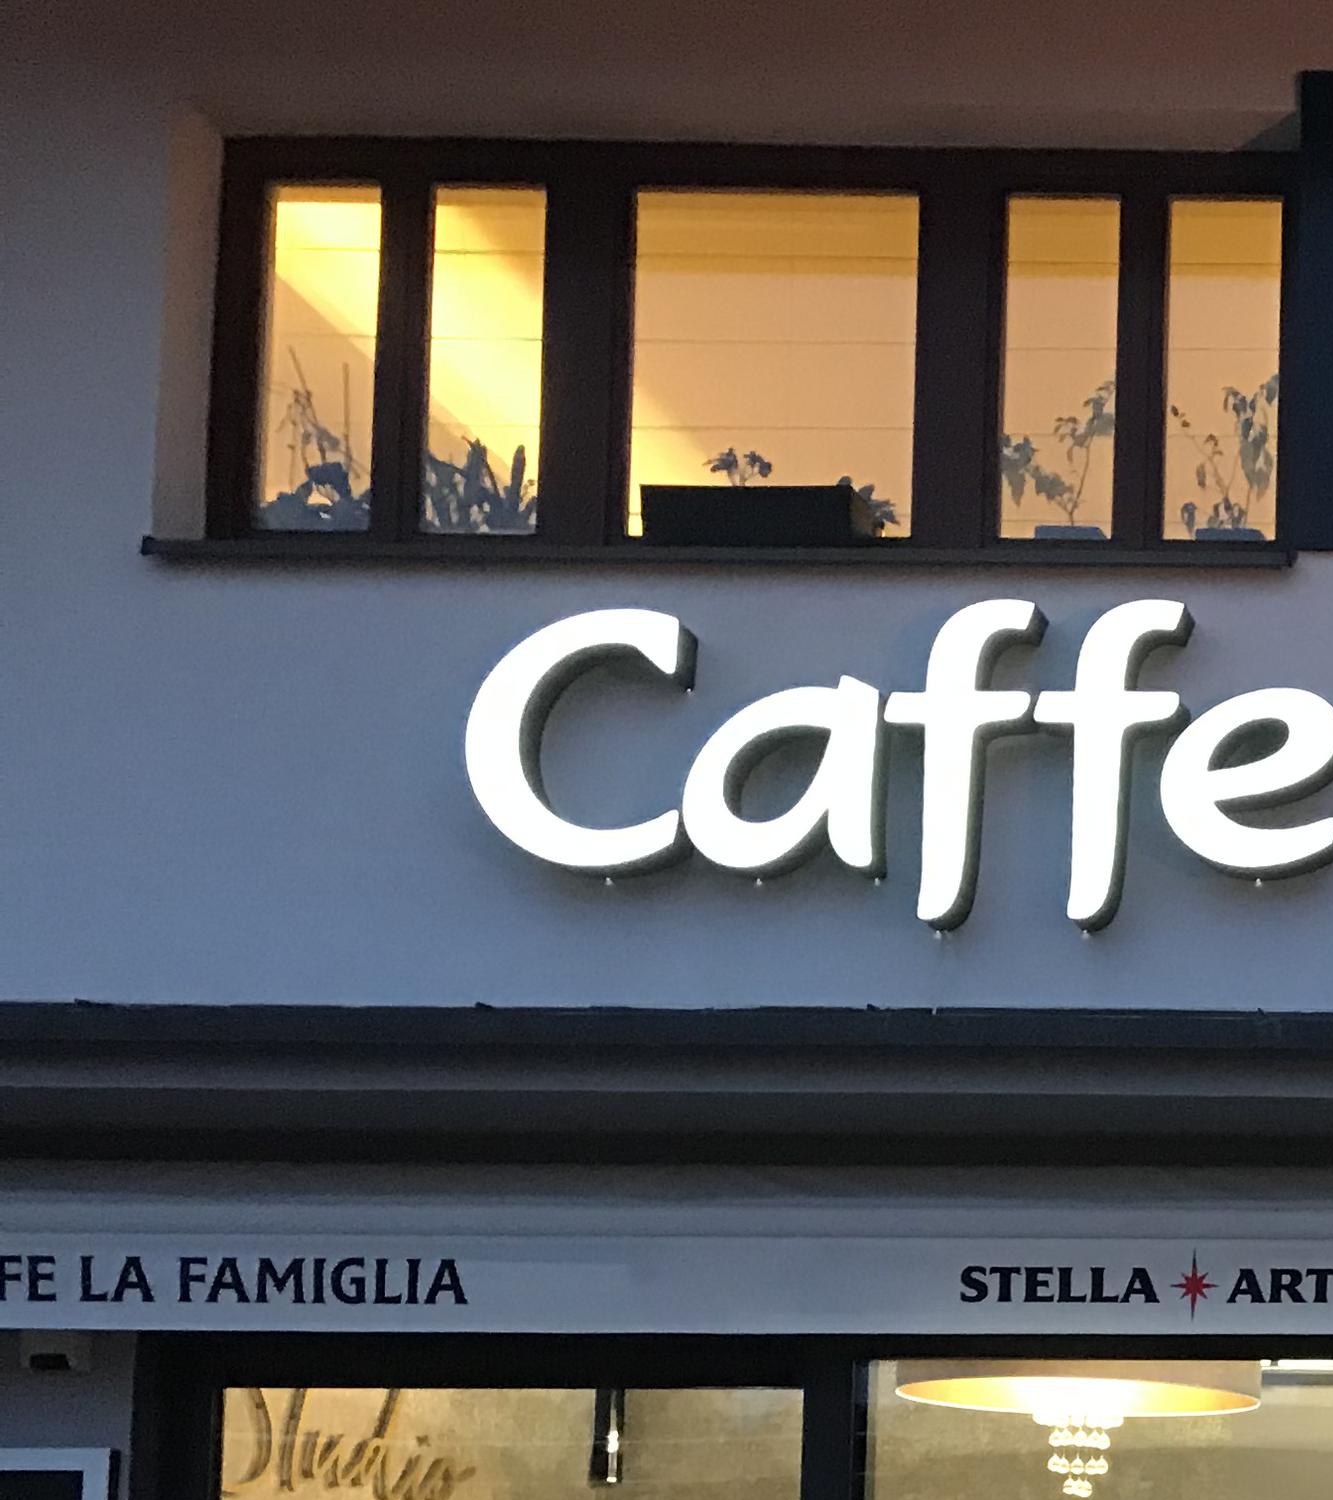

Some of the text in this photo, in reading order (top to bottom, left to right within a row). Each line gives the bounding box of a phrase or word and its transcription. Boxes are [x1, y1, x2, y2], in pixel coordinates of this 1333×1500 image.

[80, 1256, 155, 1301] LA
[177, 1257, 468, 1304] FAMIGLIA
[959, 1266, 1160, 1303] STELLA
